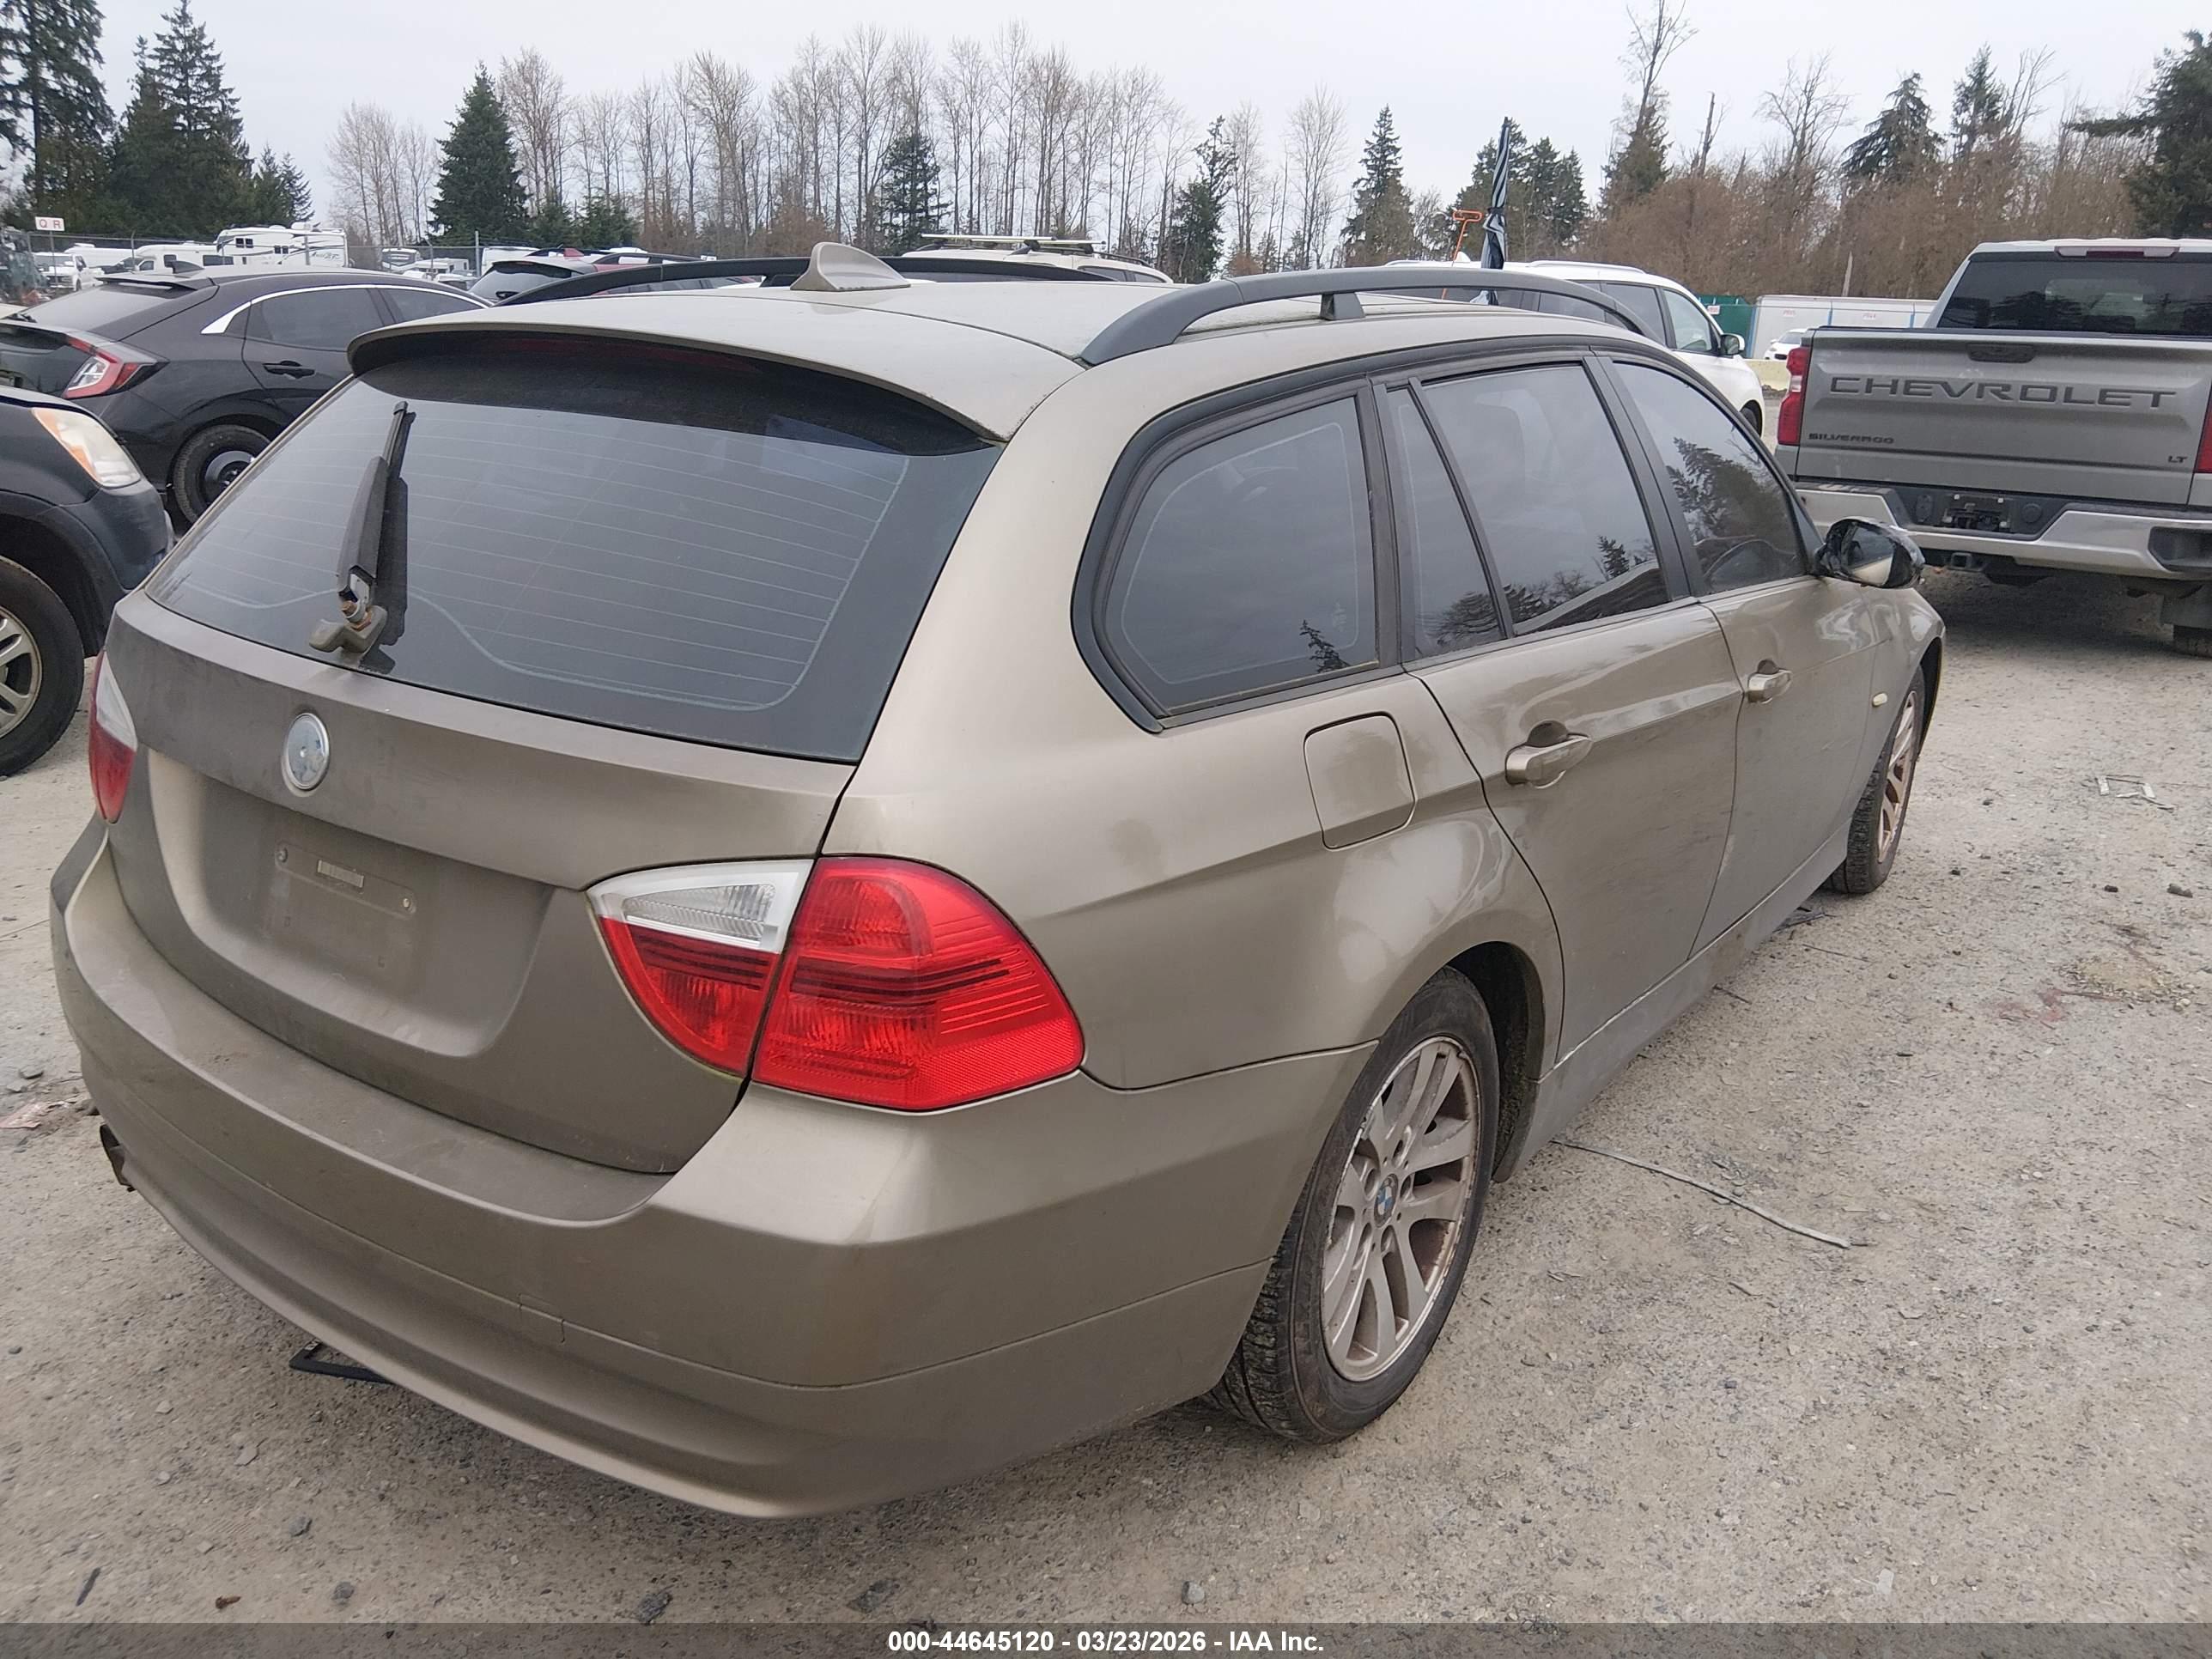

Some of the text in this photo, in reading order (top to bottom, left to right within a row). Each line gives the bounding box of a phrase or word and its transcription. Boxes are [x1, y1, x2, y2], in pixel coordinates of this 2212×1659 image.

[39, 219, 61, 229] Q R
[1830, 376, 2178, 409] CHEVROLET
[1808, 432, 1895, 445] SILVERADO
[2167, 455, 2189, 464] LT
